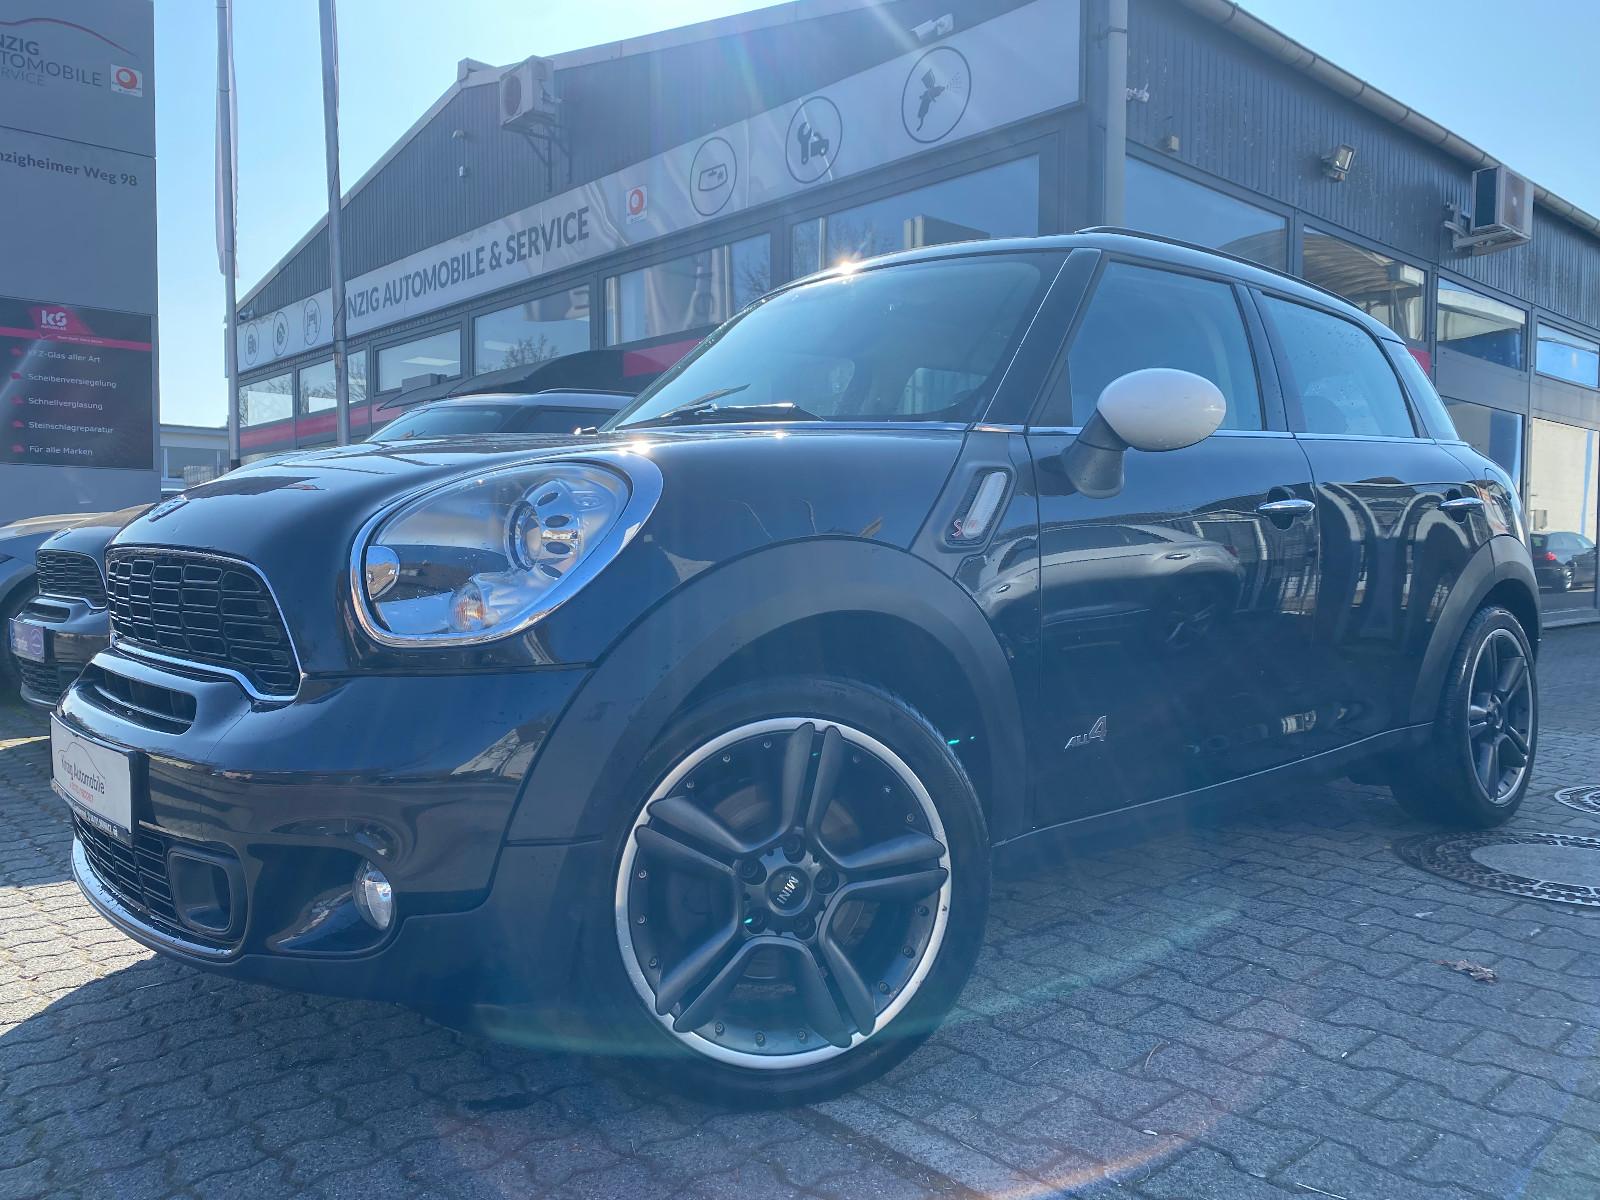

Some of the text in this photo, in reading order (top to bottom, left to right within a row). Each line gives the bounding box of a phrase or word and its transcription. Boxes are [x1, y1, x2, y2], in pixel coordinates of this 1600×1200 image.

[84, 165, 117, 185] Weg
[120, 173, 138, 187] 98
[382, 245, 486, 309] AUTOMOBILE
[489, 240, 502, 271] &
[505, 206, 590, 266] SERVICE
[28, 373, 117, 389] Scheibenversiegelung
[28, 397, 103, 411] Schnellverglasung
[28, 421, 114, 434] Steinschlagreparatur
[29, 444, 93, 456] Für alle Marken
[776, 875, 799, 905] MINI
